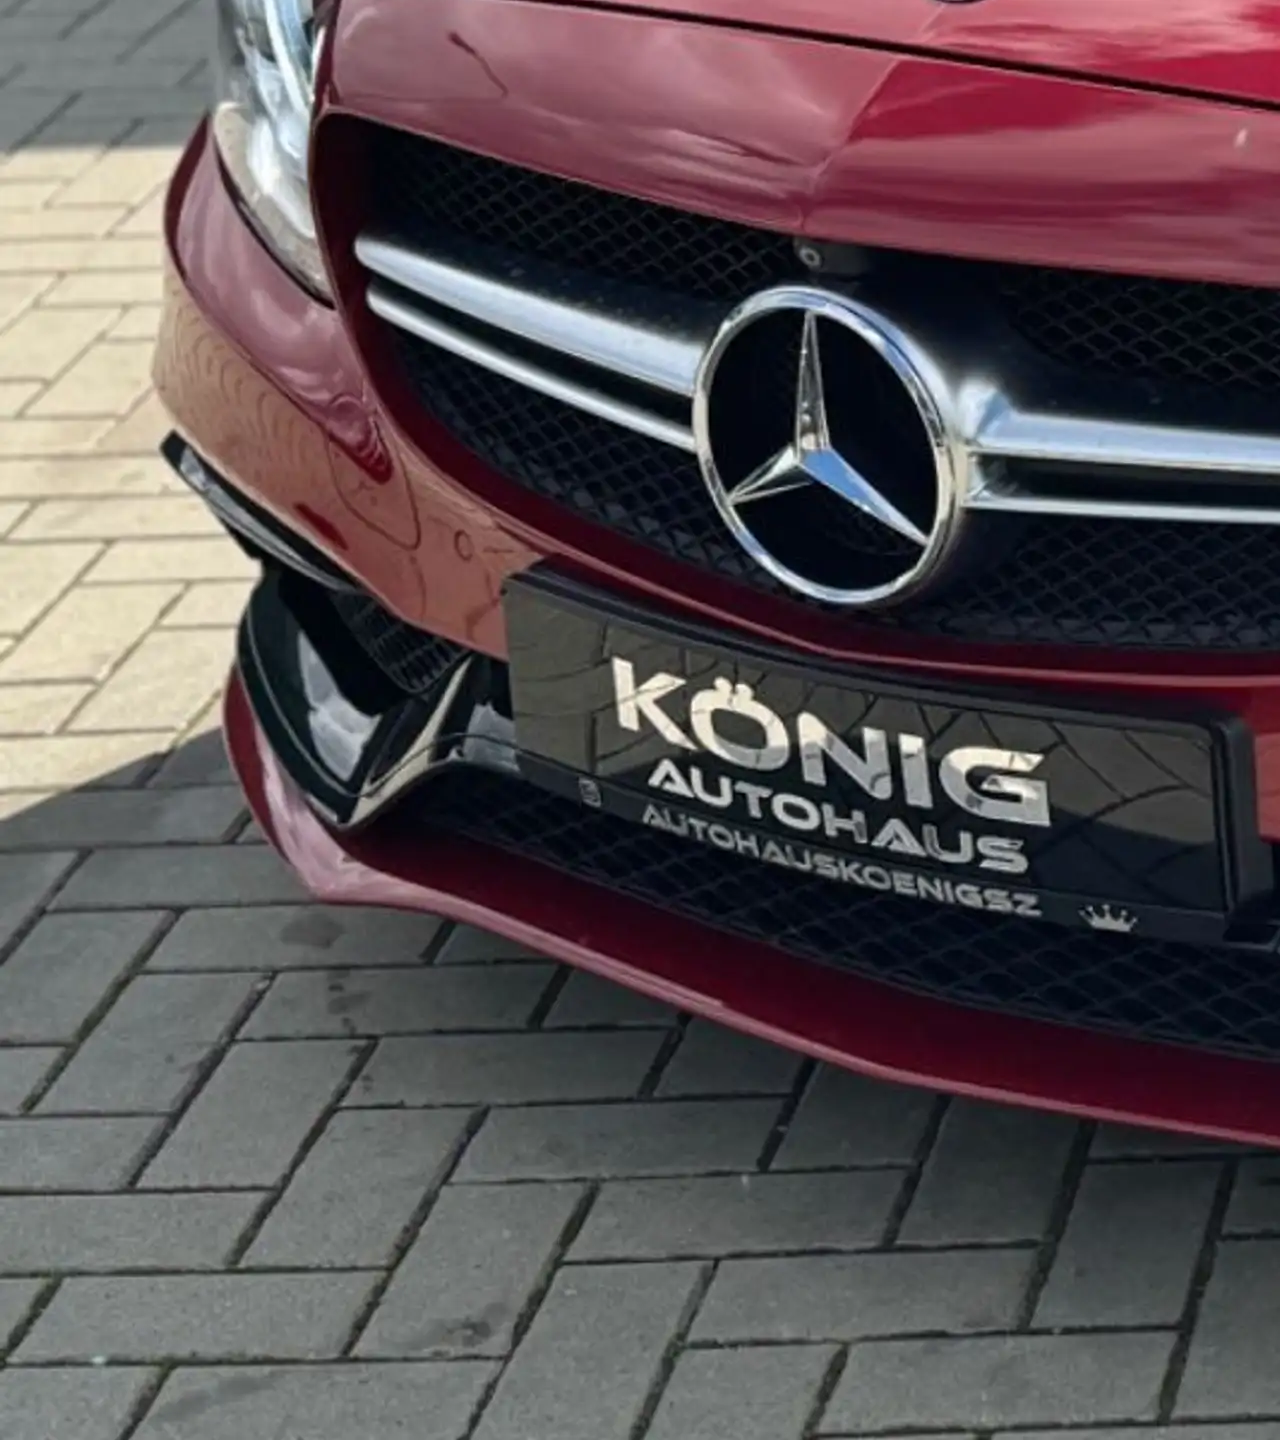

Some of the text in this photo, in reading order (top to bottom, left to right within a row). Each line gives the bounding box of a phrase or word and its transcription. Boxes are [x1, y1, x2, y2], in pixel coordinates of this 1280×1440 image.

[613, 657, 1051, 827] KÖNIG
[642, 803, 1042, 917] AUTOHAUSKOENIGSZ
[648, 759, 1028, 874] AUTOHAUS
